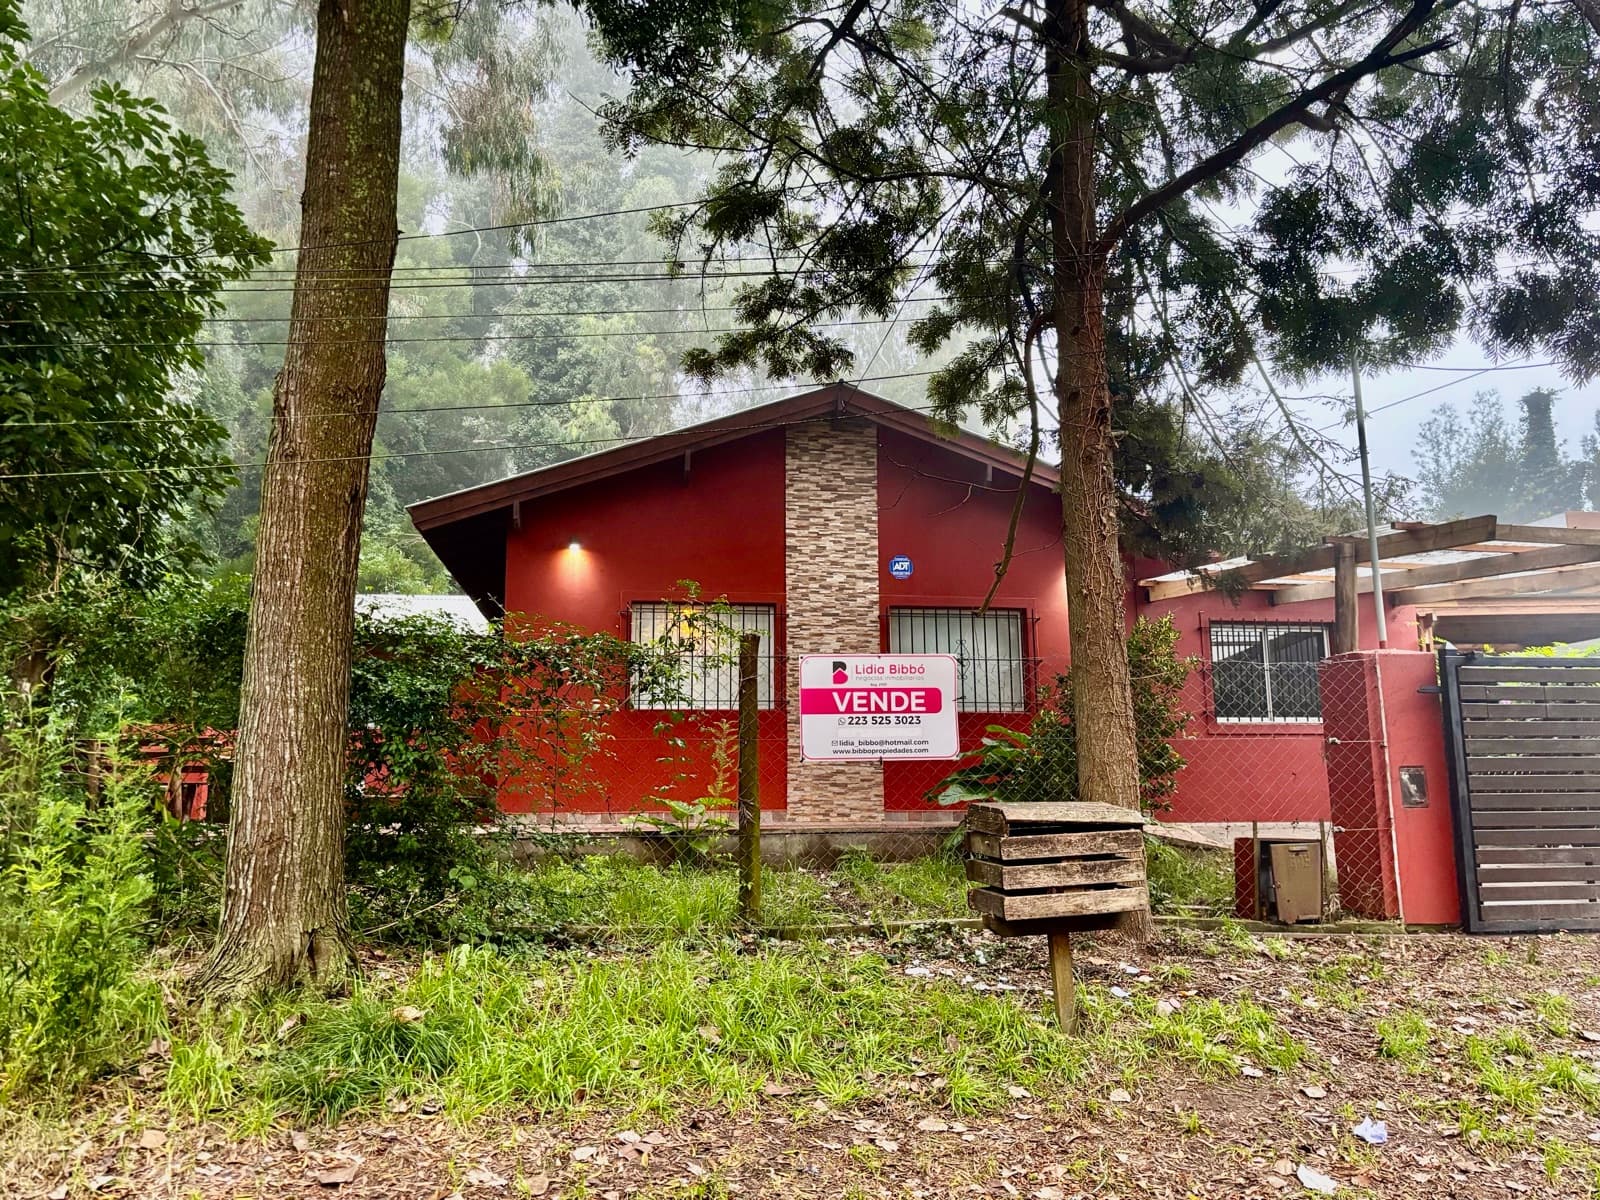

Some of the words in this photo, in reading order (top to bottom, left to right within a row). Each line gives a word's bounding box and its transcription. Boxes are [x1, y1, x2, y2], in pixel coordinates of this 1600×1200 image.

[893, 561, 910, 570] ADT
[855, 664, 885, 675] Lidia
[889, 664, 925, 675] Bibbó
[832, 691, 926, 712] VENDE
[848, 716, 868, 725] 223
[871, 716, 891, 725] 525
[894, 715, 921, 725] 3023
[839, 739, 929, 747] lidia_bibbo@hotmail.com
[832, 747, 929, 755] www.bibbopropiedades.com
